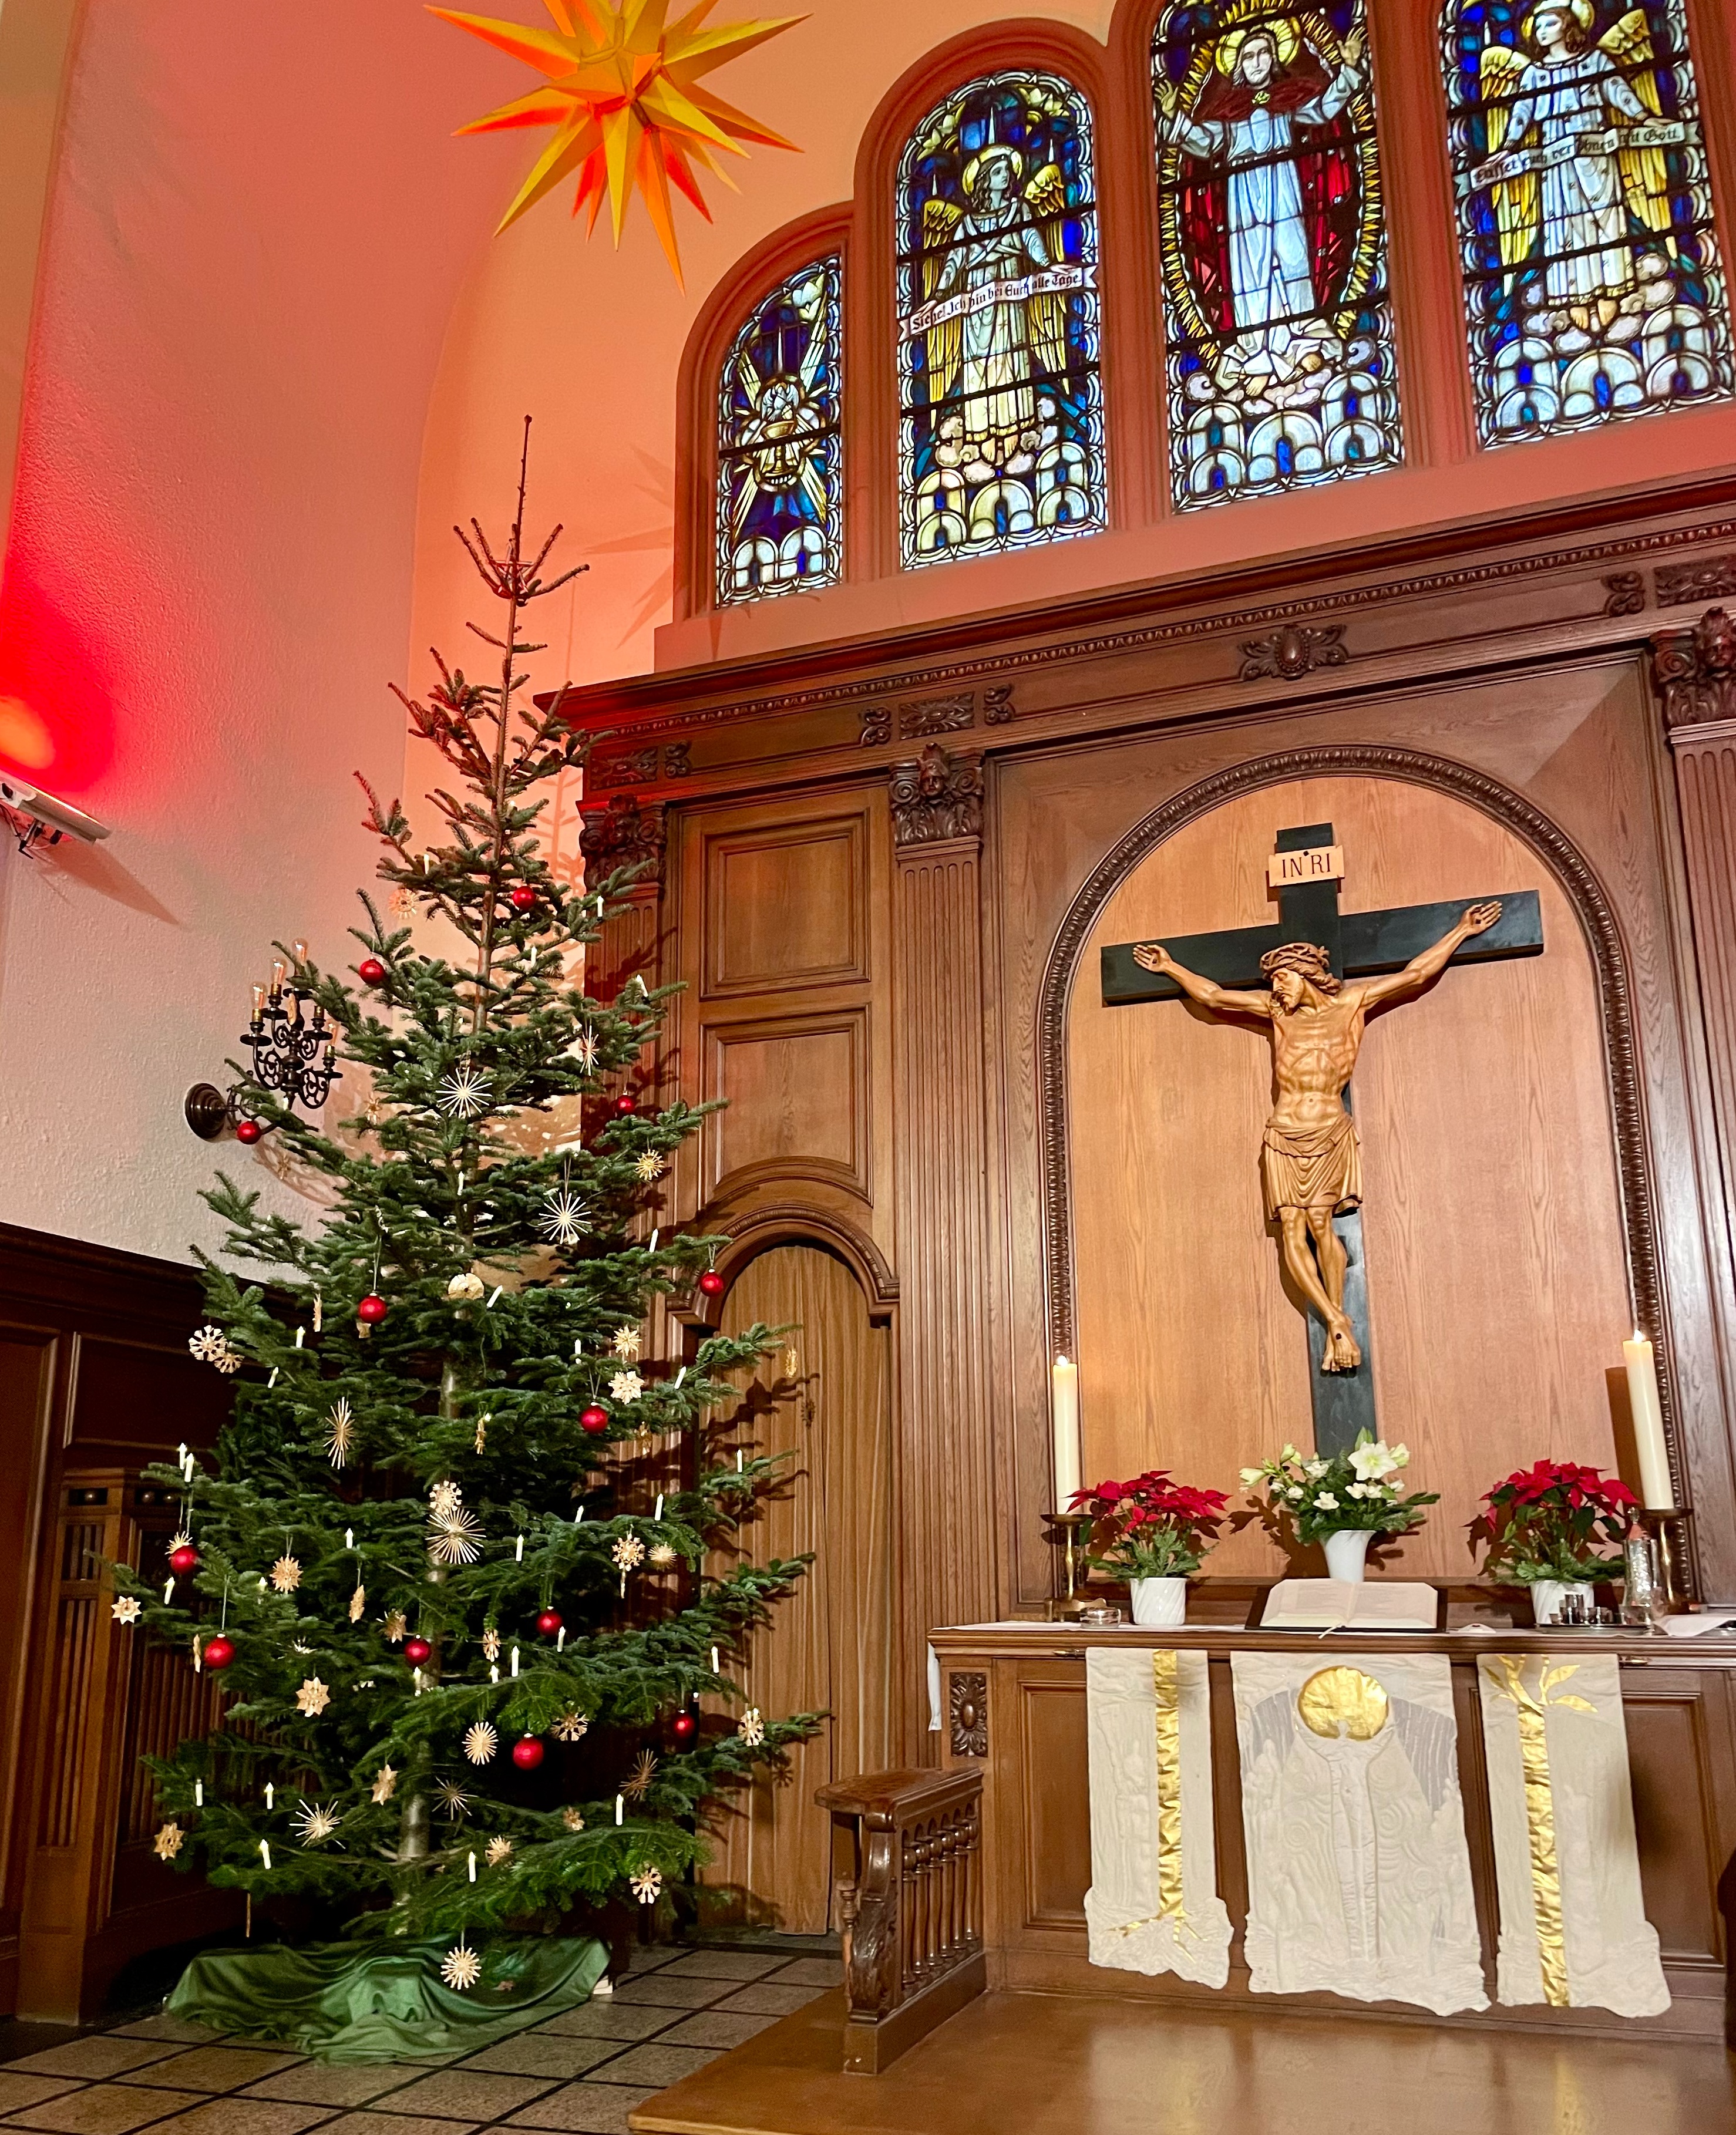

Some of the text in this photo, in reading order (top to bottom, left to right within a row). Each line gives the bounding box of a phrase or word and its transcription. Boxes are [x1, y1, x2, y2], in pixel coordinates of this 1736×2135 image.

[947, 297, 967, 315] Ich
[969, 294, 986, 307] bin
[988, 287, 1002, 299] bei
[1032, 275, 1050, 288] alle
[1052, 273, 1080, 287] Tage
